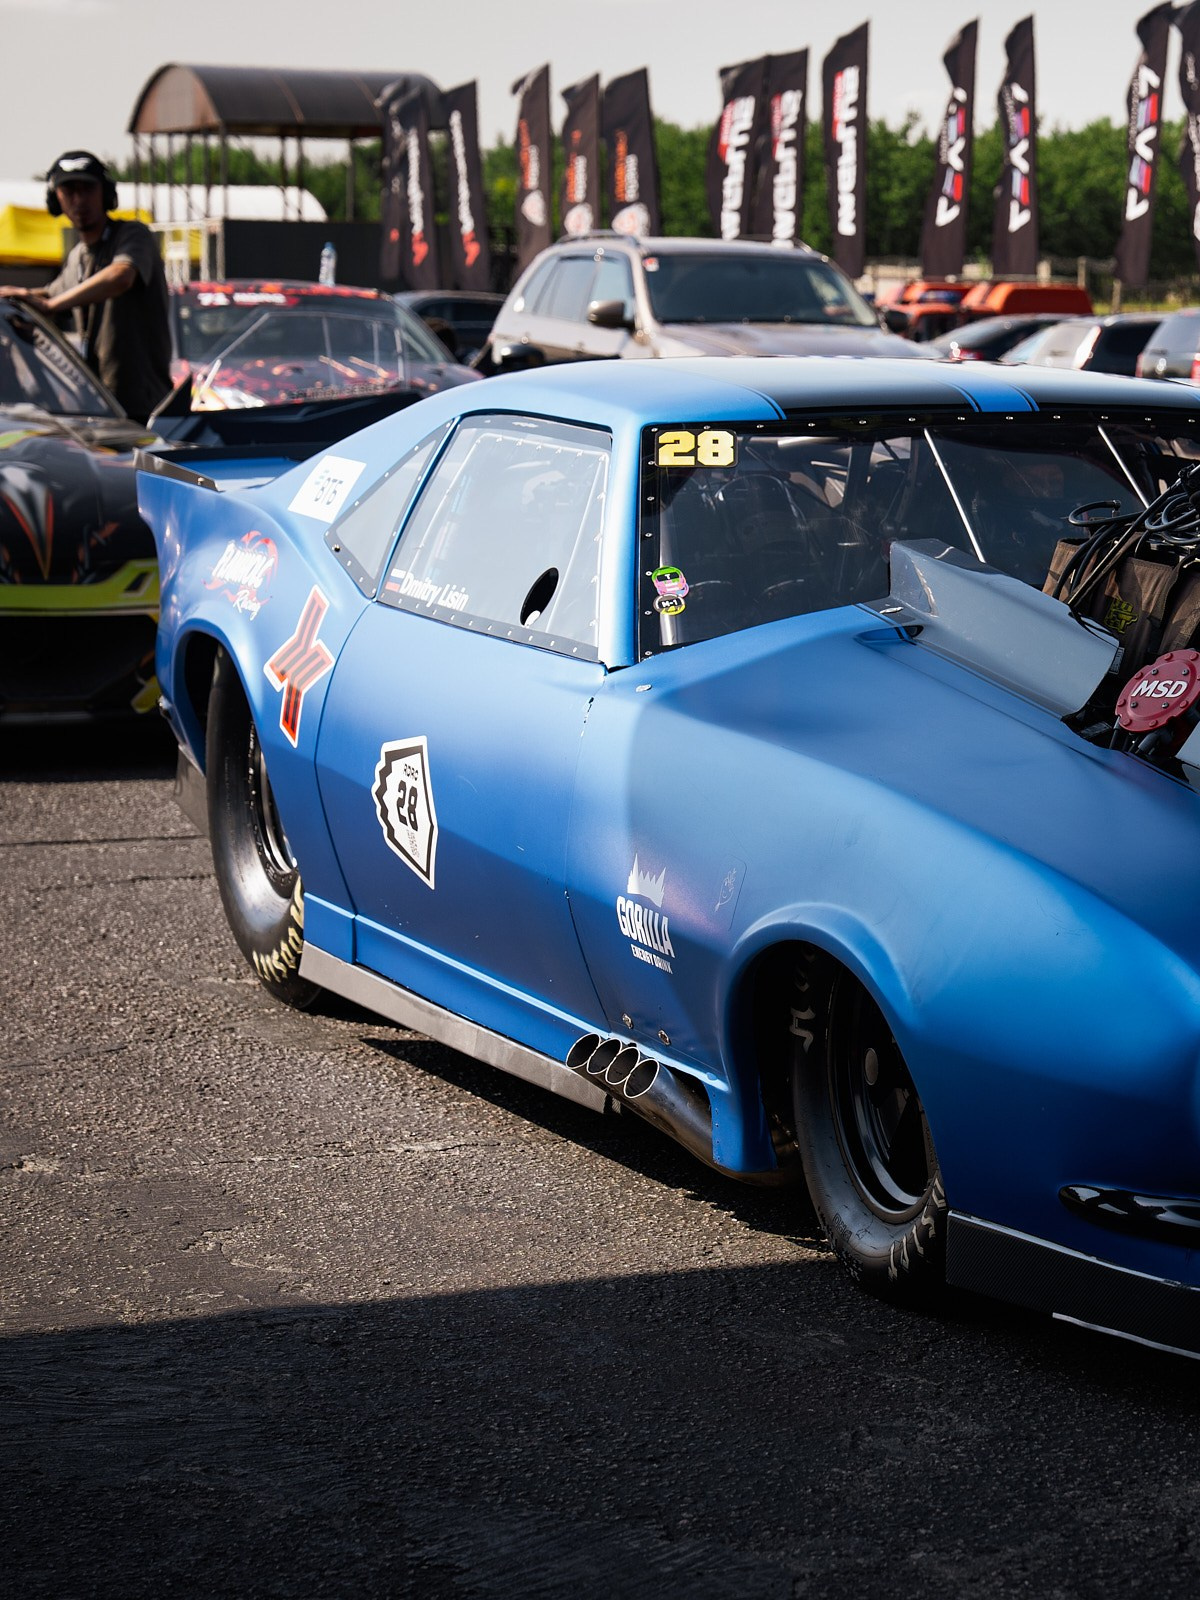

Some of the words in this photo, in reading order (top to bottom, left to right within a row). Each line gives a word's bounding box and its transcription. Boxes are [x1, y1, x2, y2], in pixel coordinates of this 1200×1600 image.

[658, 430, 734, 466] 28
[398, 571, 442, 608] Dmitry
[437, 583, 470, 611] Lisin
[1131, 680, 1188, 698] MSD
[396, 779, 419, 832] 28
[616, 895, 675, 958] GORILLA
[630, 944, 654, 966] ENERGY
[652, 954, 673, 974] DRINK
